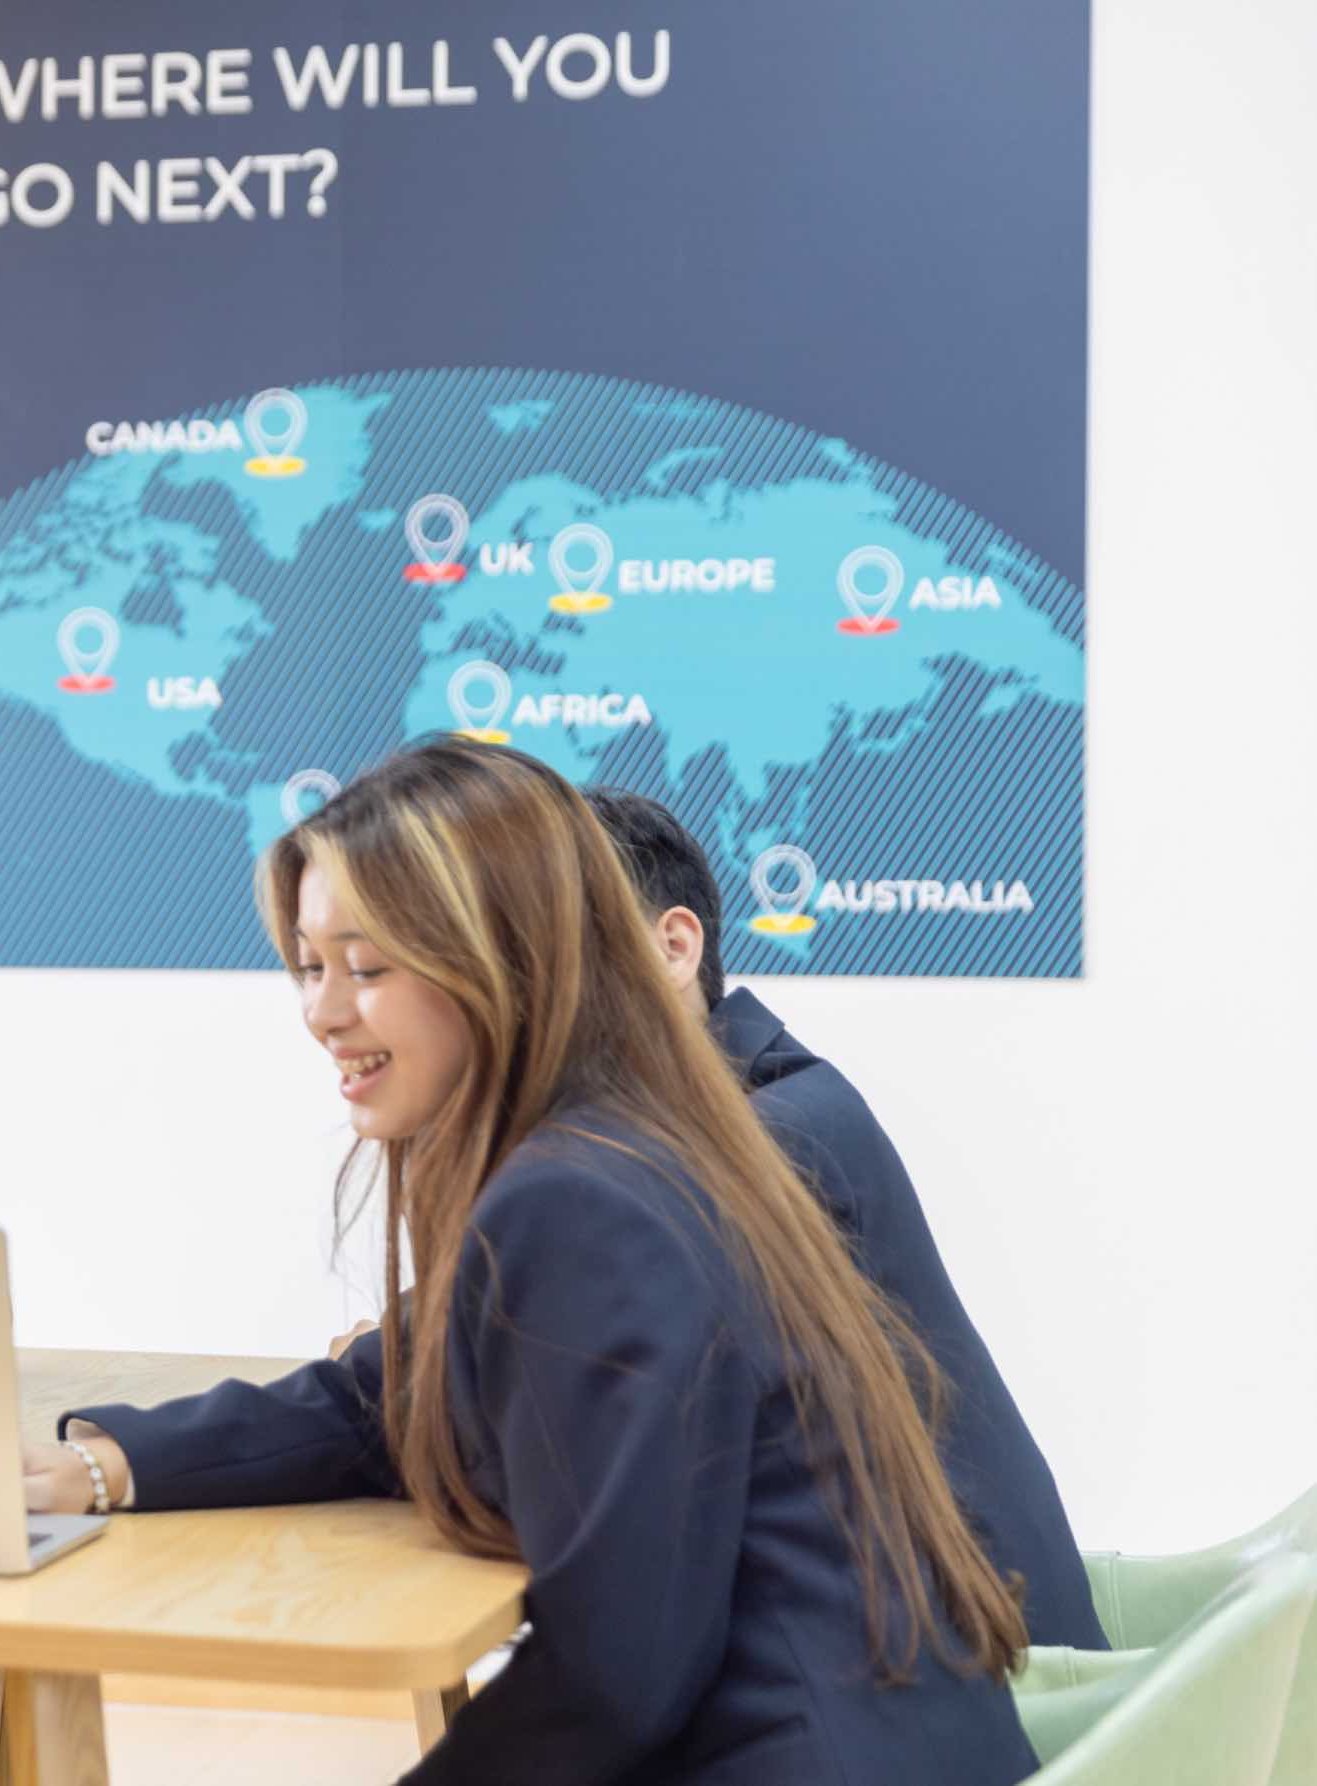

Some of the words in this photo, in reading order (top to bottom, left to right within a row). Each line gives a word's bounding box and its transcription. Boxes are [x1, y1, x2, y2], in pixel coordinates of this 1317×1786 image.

[274, 39, 477, 112] WILL
[494, 30, 670, 103] YOU
[96, 149, 338, 224] NEXT?
[85, 420, 242, 455] CANADA
[480, 543, 534, 574] UK
[619, 558, 776, 593] EUROPE
[909, 576, 1001, 610] ASIA
[147, 677, 221, 709] USA
[512, 694, 651, 727] AFRICA
[816, 880, 1033, 913] AUSTRALIA
